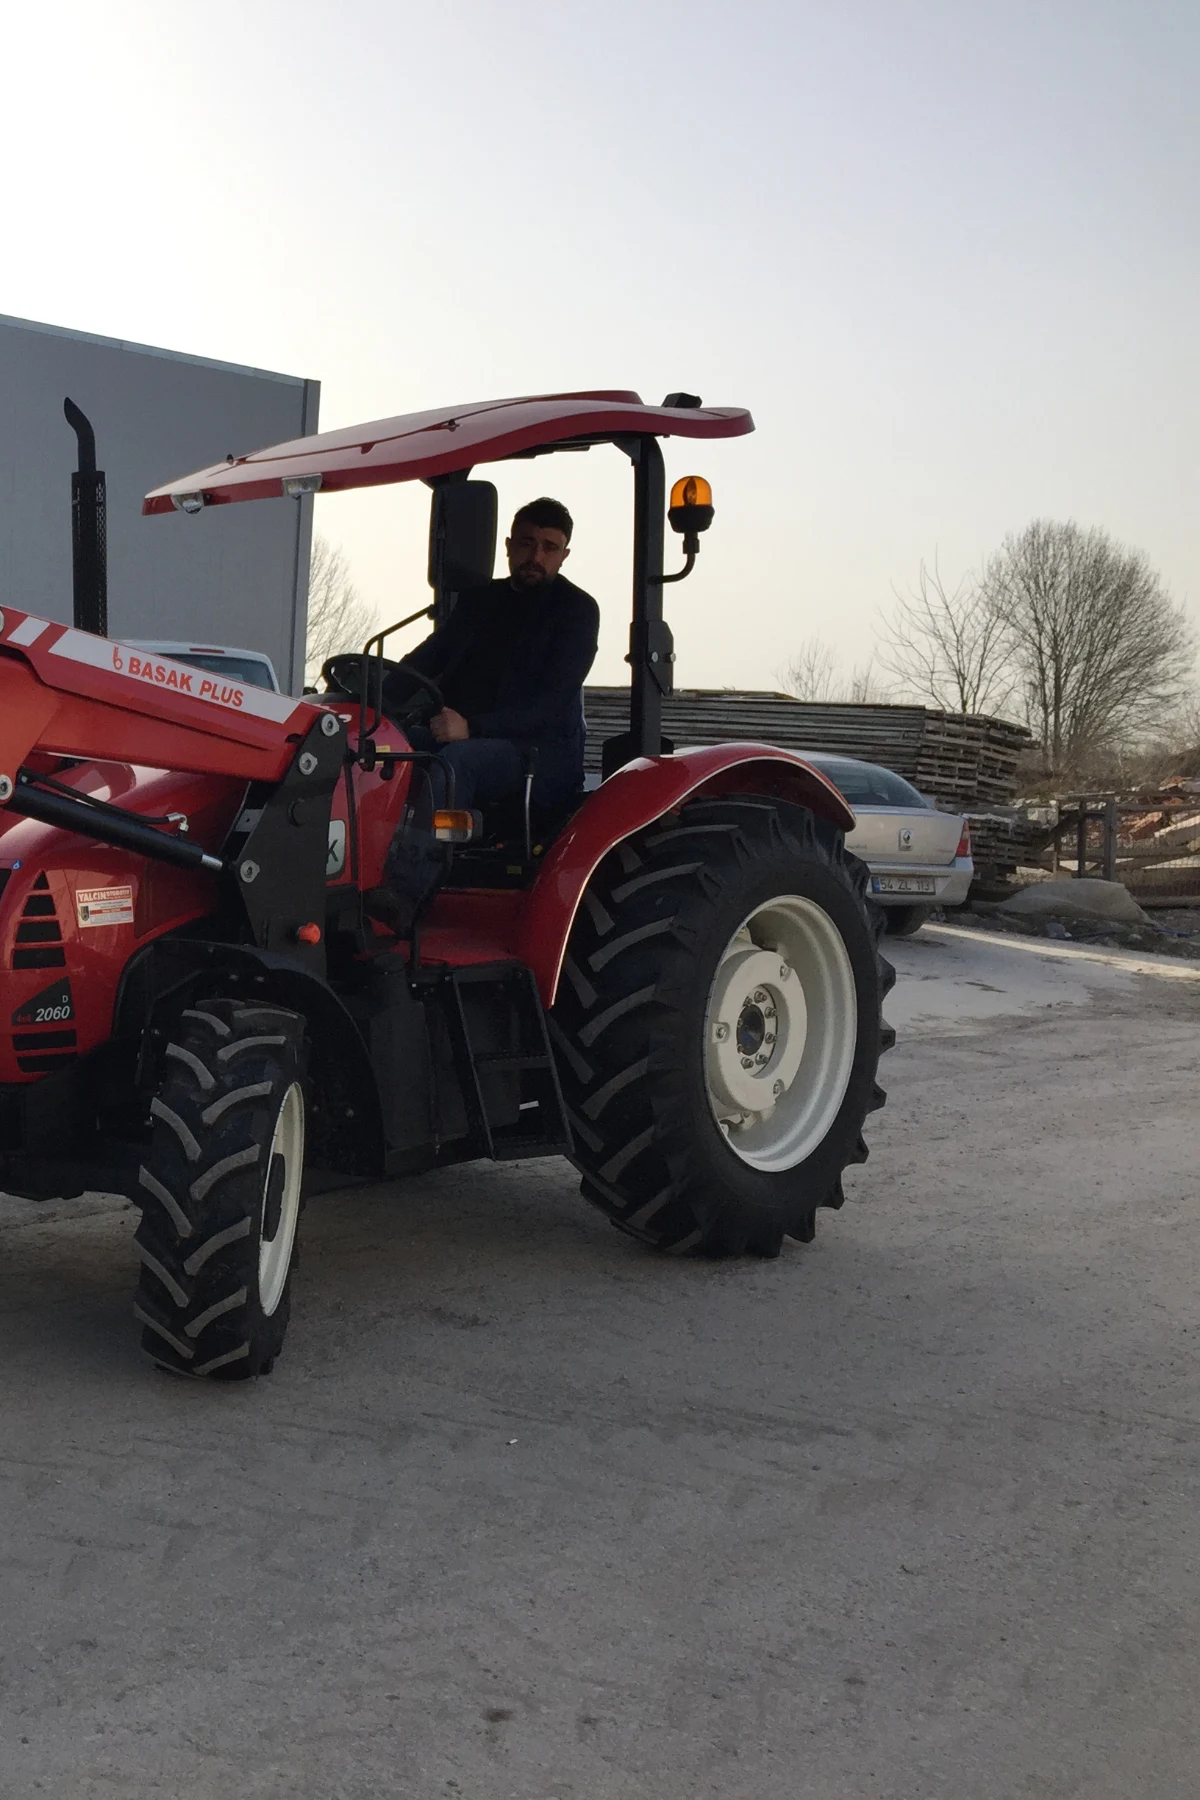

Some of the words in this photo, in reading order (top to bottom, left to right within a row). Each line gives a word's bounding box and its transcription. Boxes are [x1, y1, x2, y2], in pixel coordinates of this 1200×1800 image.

[128, 656, 193, 692] BASAK
[200, 679, 244, 708] PLUS
[881, 879, 893, 890] 54
[898, 878, 911, 890] ZL
[62, 995, 69, 1004] D
[35, 1005, 70, 1022] 2060
